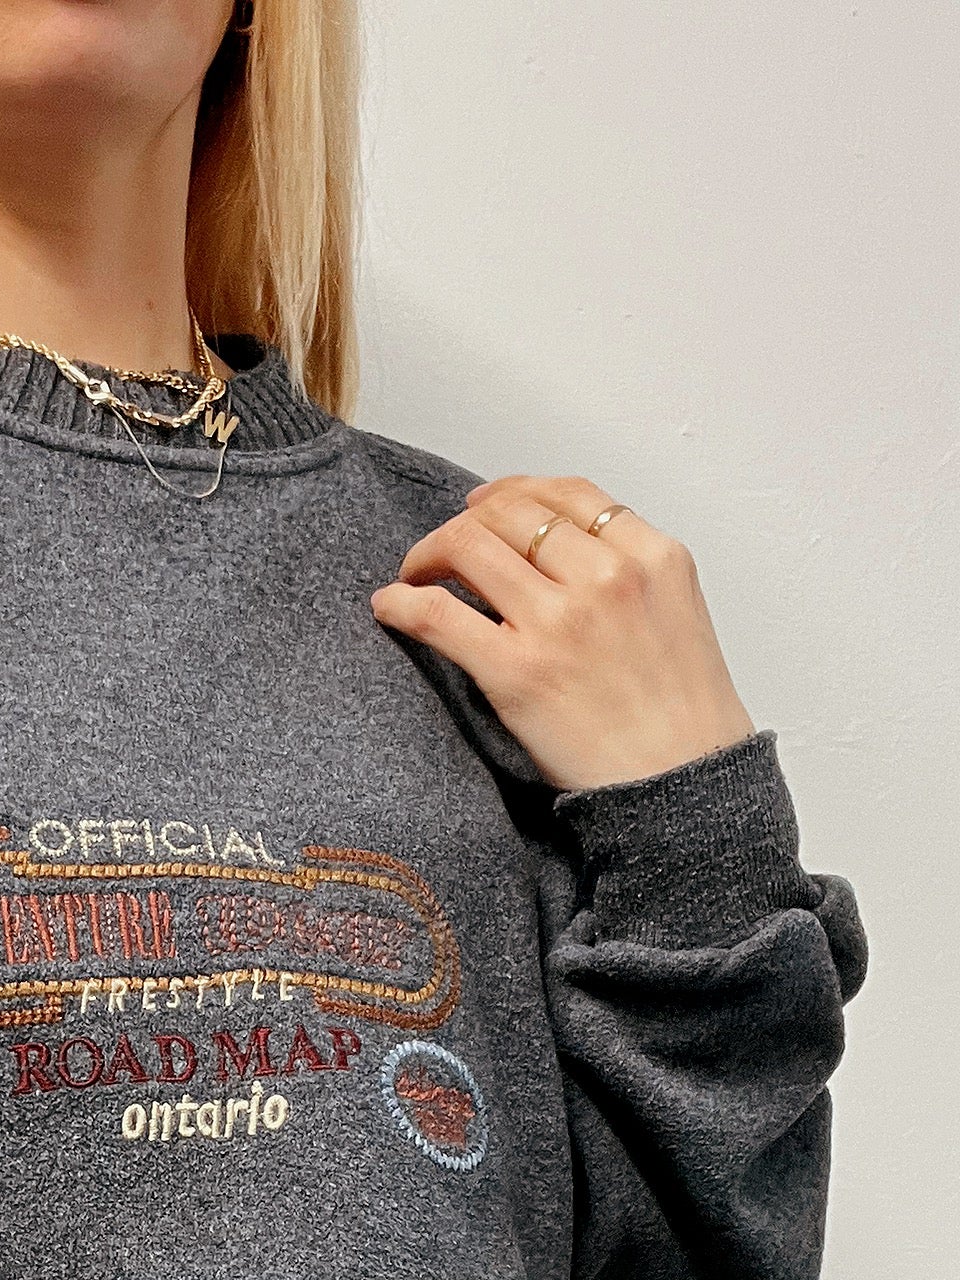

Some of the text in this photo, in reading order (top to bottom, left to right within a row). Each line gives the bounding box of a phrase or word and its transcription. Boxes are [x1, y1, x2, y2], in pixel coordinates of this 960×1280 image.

[28, 818, 286, 868] OFFICIAL
[79, 967, 294, 1014] FRESTYLE
[7, 1024, 362, 1097] ROAD MAP
[121, 1080, 289, 1142] ontario
